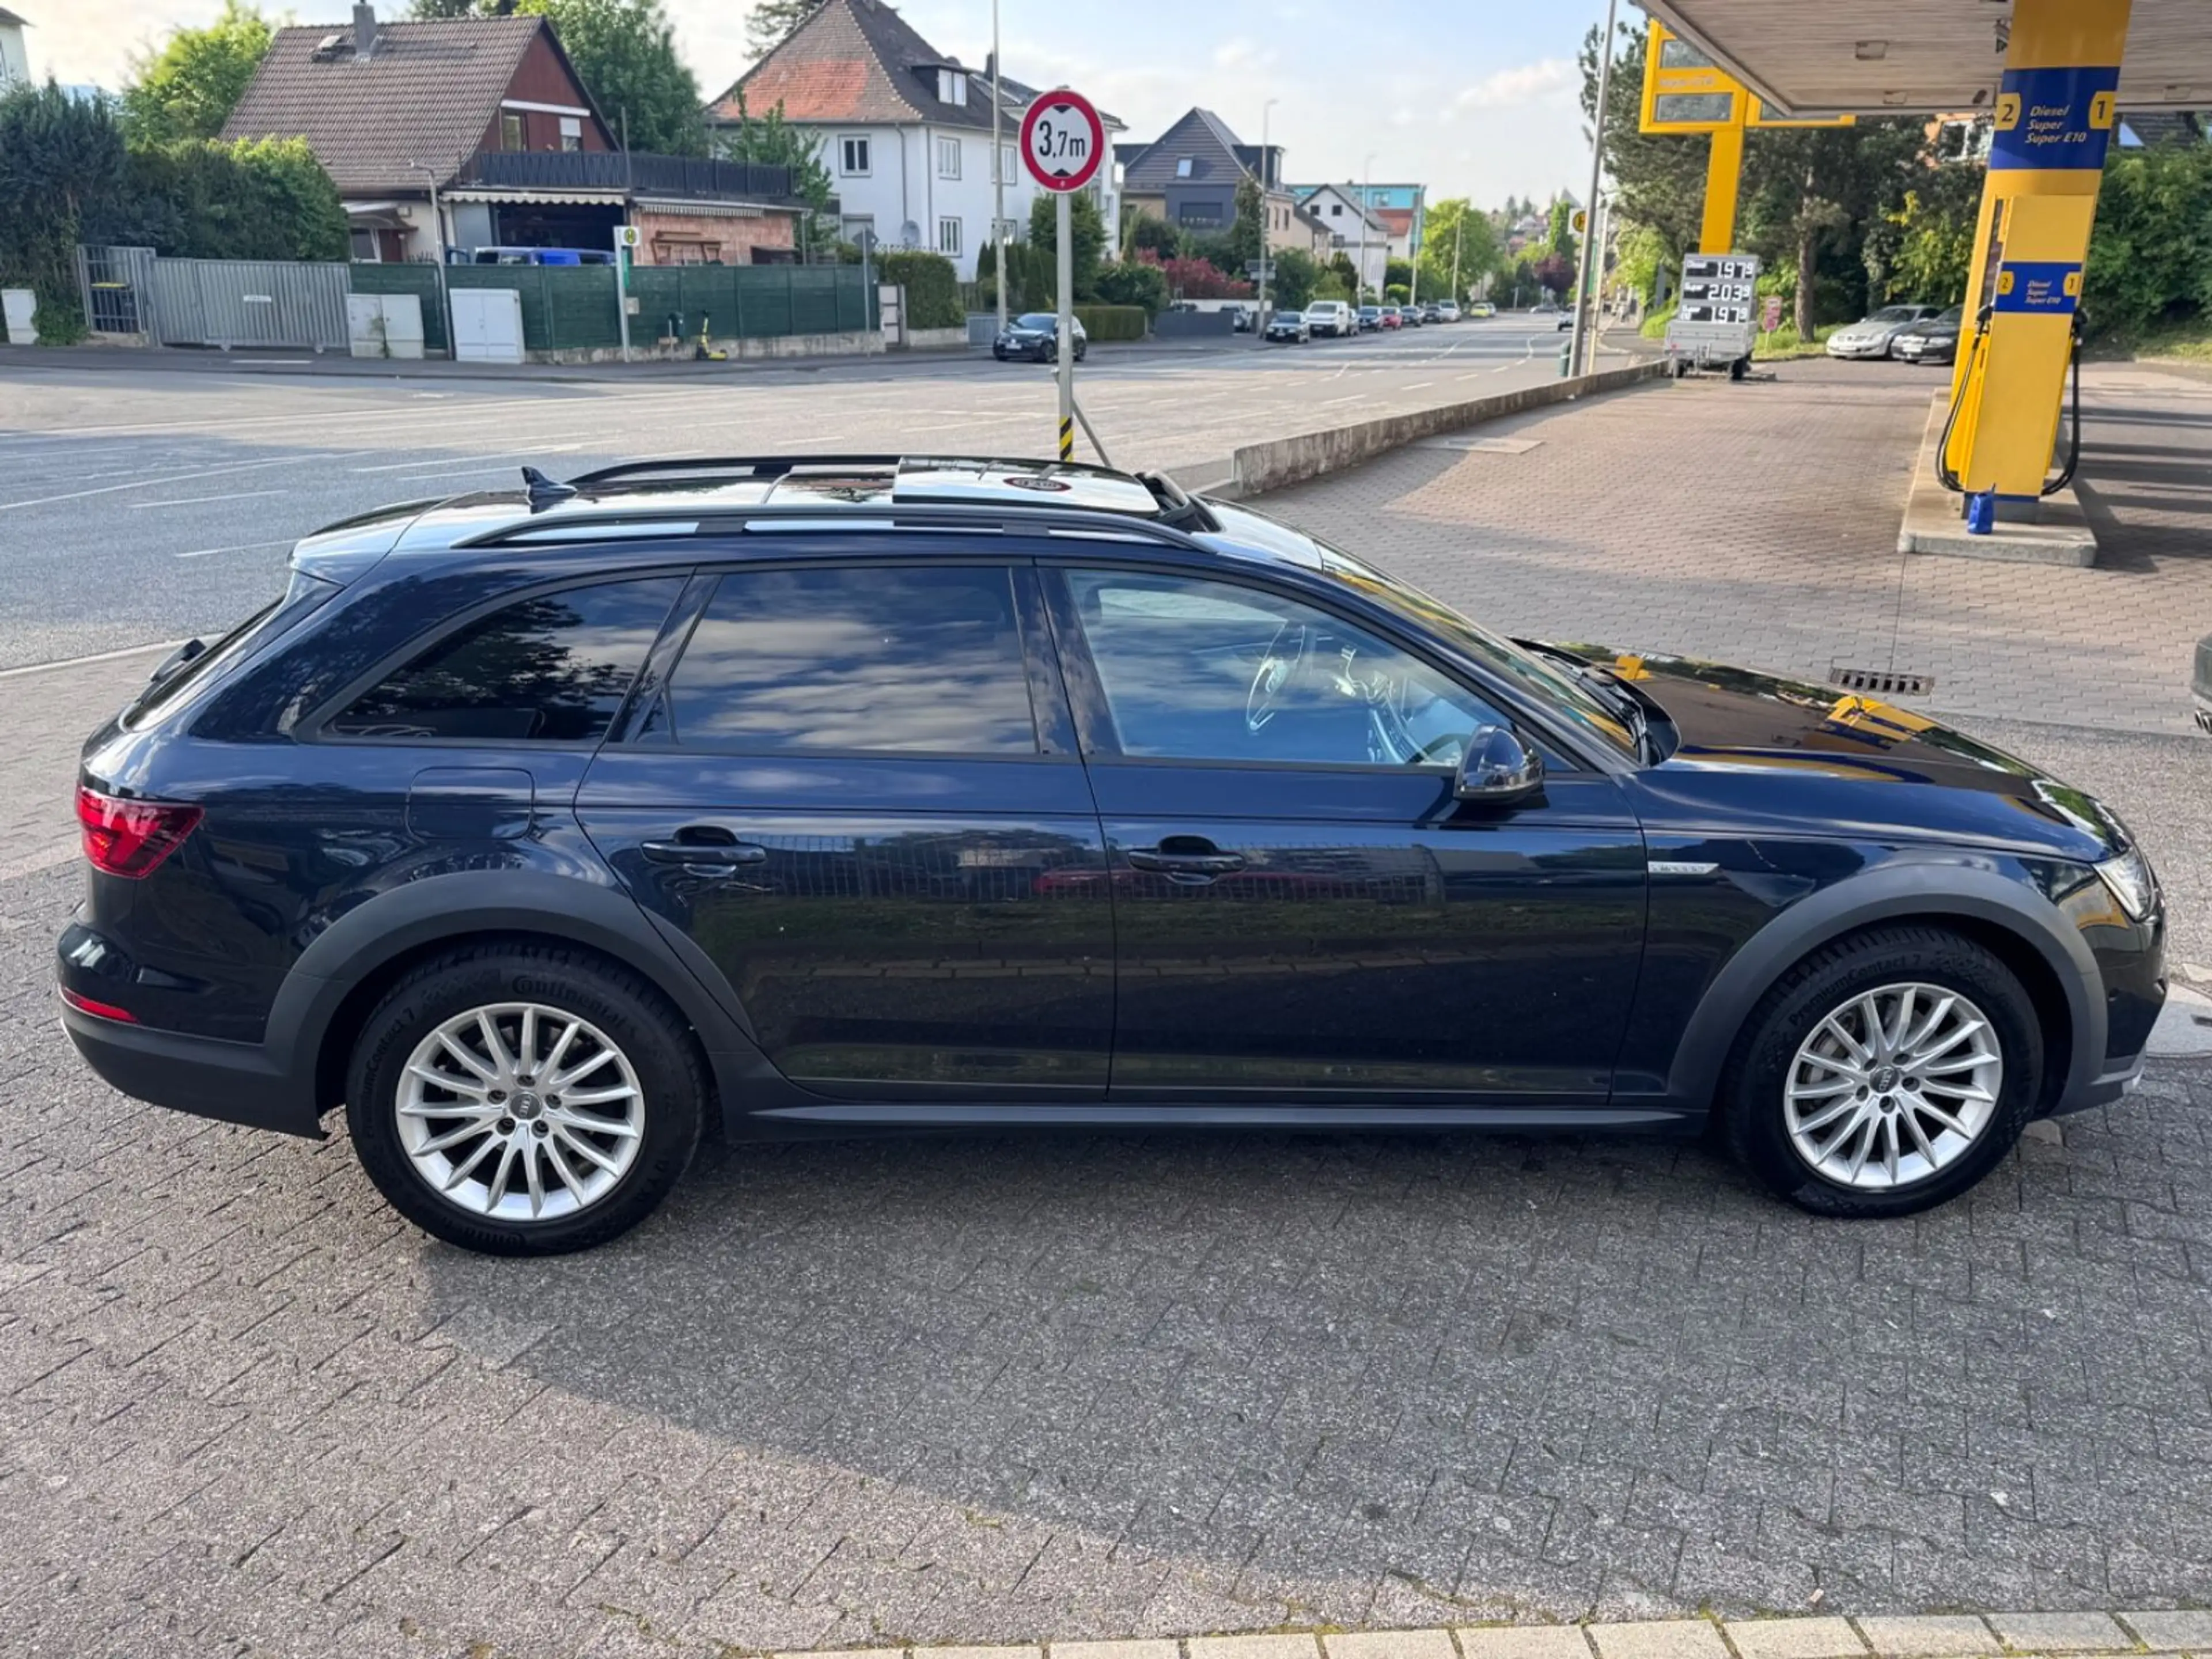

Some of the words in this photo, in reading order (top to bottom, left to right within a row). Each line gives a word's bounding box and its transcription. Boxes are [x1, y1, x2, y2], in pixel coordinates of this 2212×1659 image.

[2002, 104, 2014, 122] 2
[2030, 104, 2070, 117] Diesel
[2097, 100, 2106, 120] 1
[2026, 119, 2063, 133] Super
[2024, 132, 2062, 147] Super
[2063, 131, 2087, 142] E10
[2002, 278, 2008, 289] 2
[512, 974, 628, 1028] Continental
